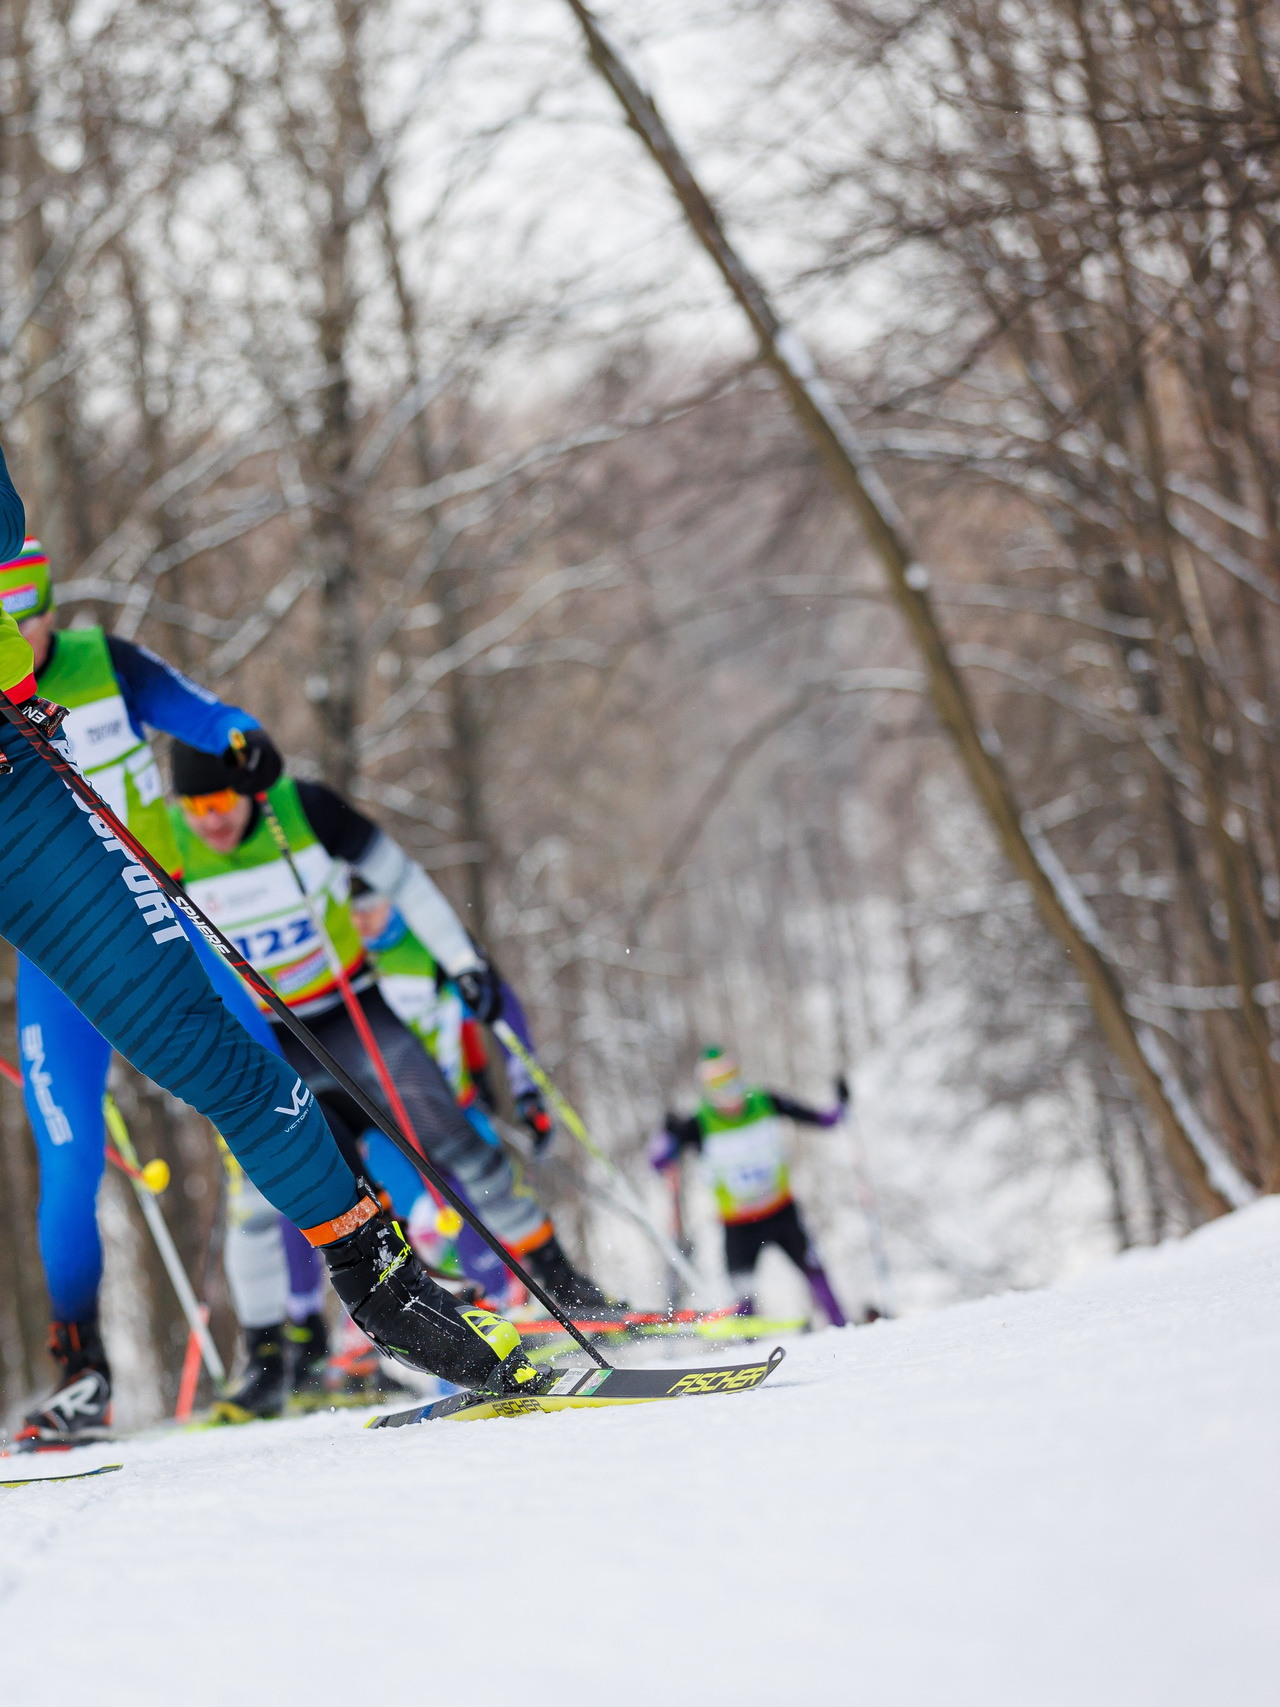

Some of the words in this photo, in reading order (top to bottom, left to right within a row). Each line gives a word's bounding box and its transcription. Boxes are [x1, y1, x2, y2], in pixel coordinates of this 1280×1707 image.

[171, 896, 231, 955] SPHERE
[284, 1108, 309, 1133] VICTORY
[666, 1366, 769, 1394] FISCHER
[491, 1399, 548, 1416] FISCHER
